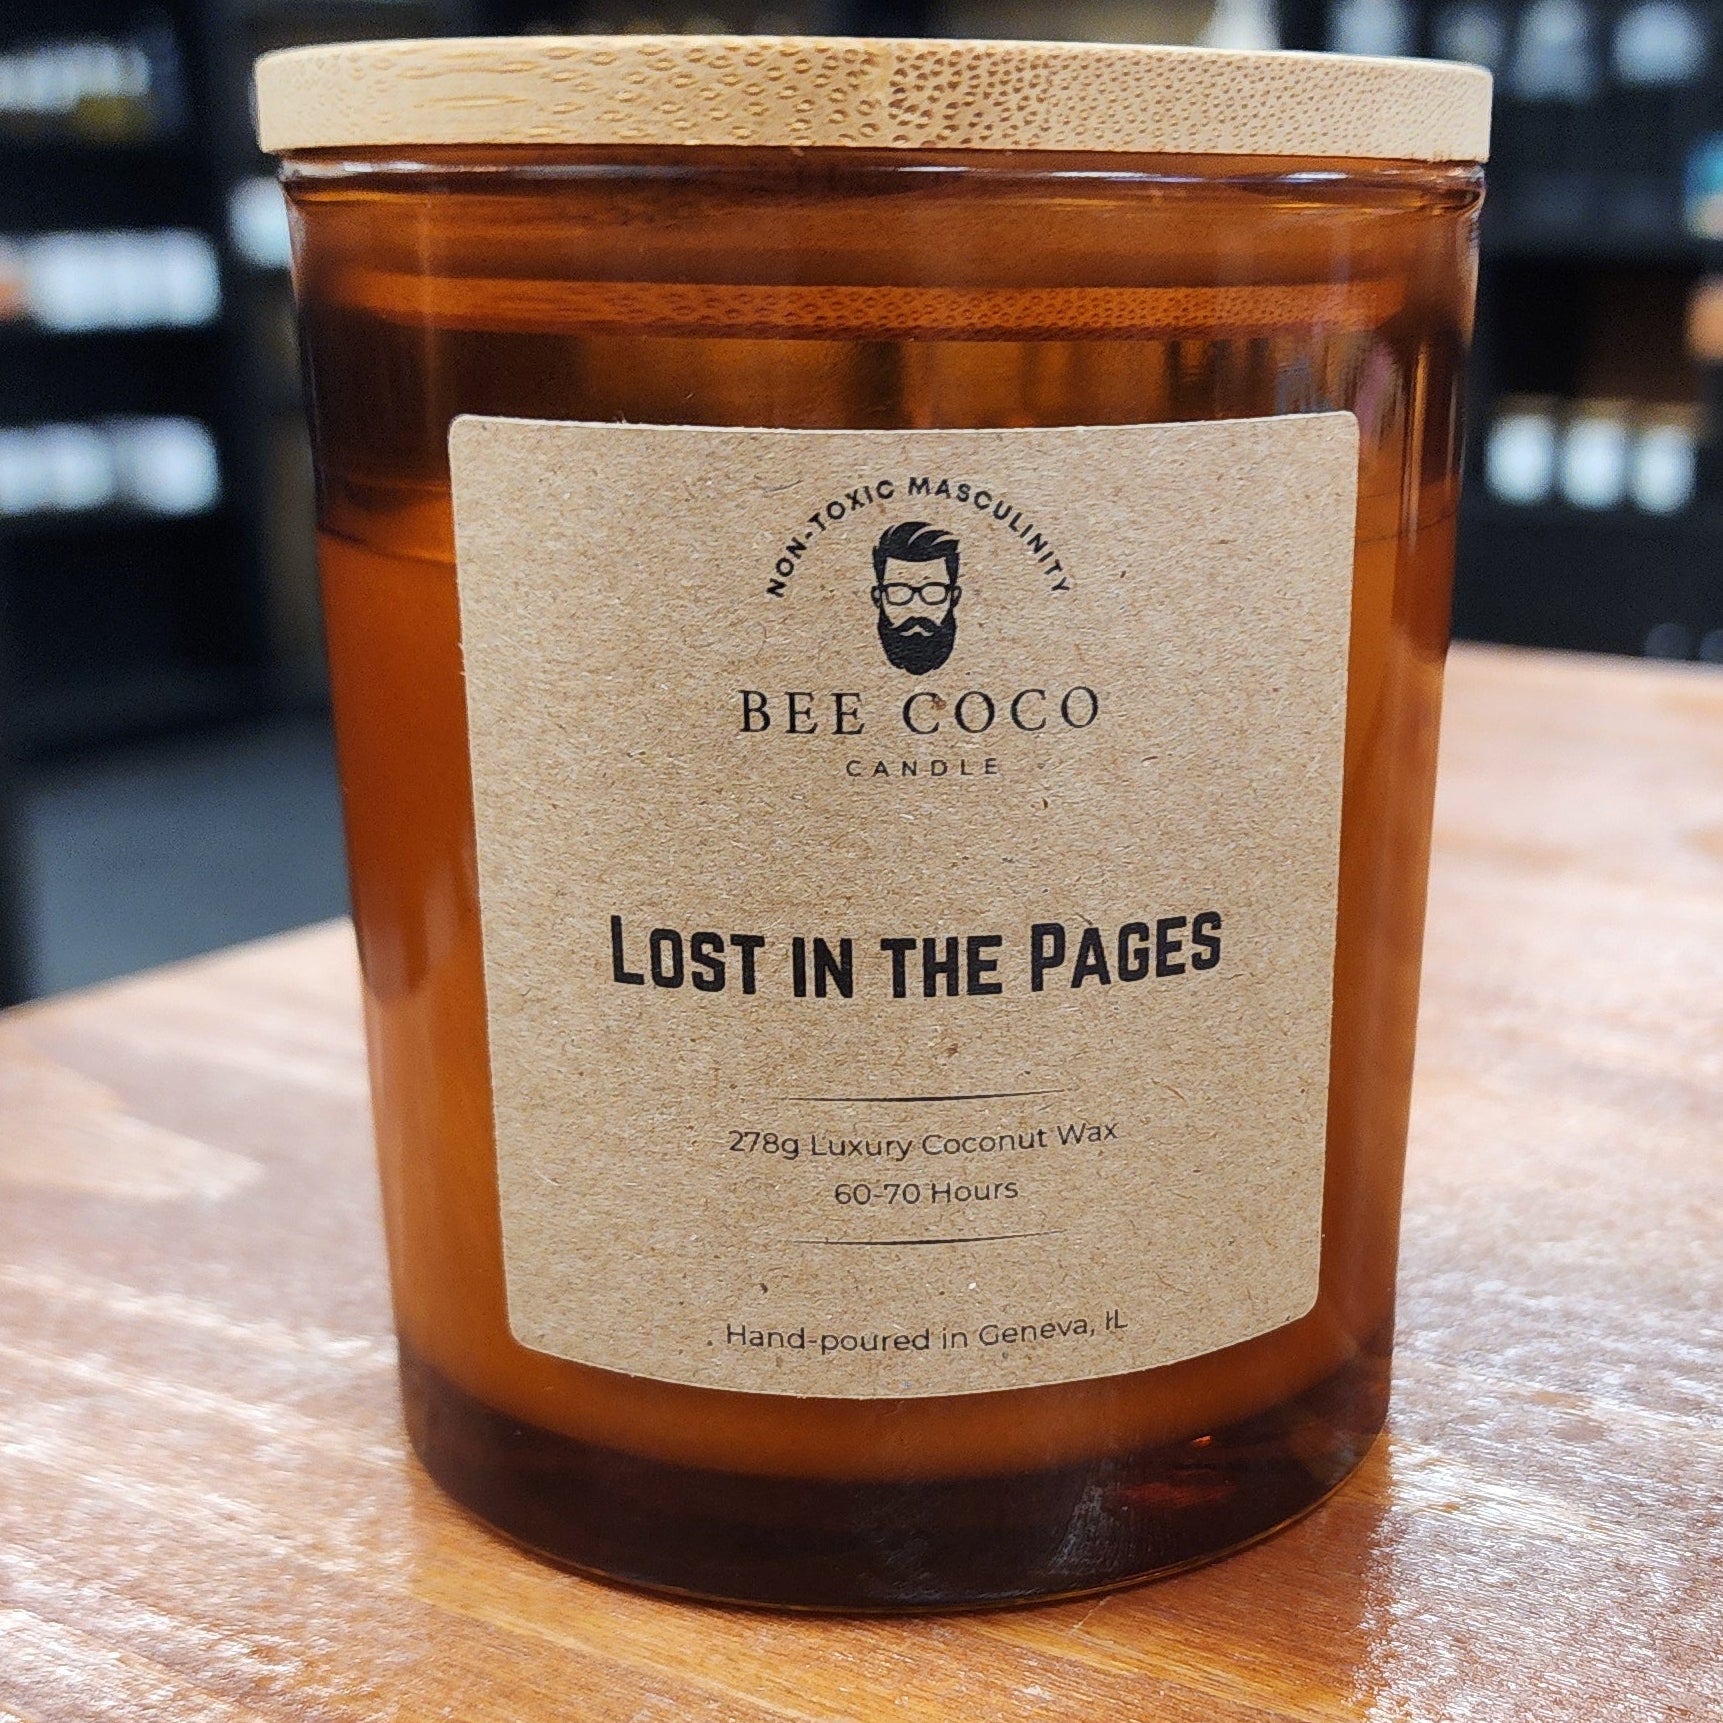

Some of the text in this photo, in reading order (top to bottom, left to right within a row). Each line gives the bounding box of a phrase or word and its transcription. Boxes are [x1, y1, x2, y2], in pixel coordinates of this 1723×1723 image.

[765, 476, 1071, 598] NON-TOXIC MASCULINITY
[739, 685, 1099, 735] BEE COCO
[846, 758, 999, 777] CANDLE
[729, 1122, 1119, 1161] 278g Luxury Coconut Wax
[835, 1179, 1019, 1205] 60-70 Hours
[726, 1308, 1128, 1354] Hand-poured in Geneva, IL
